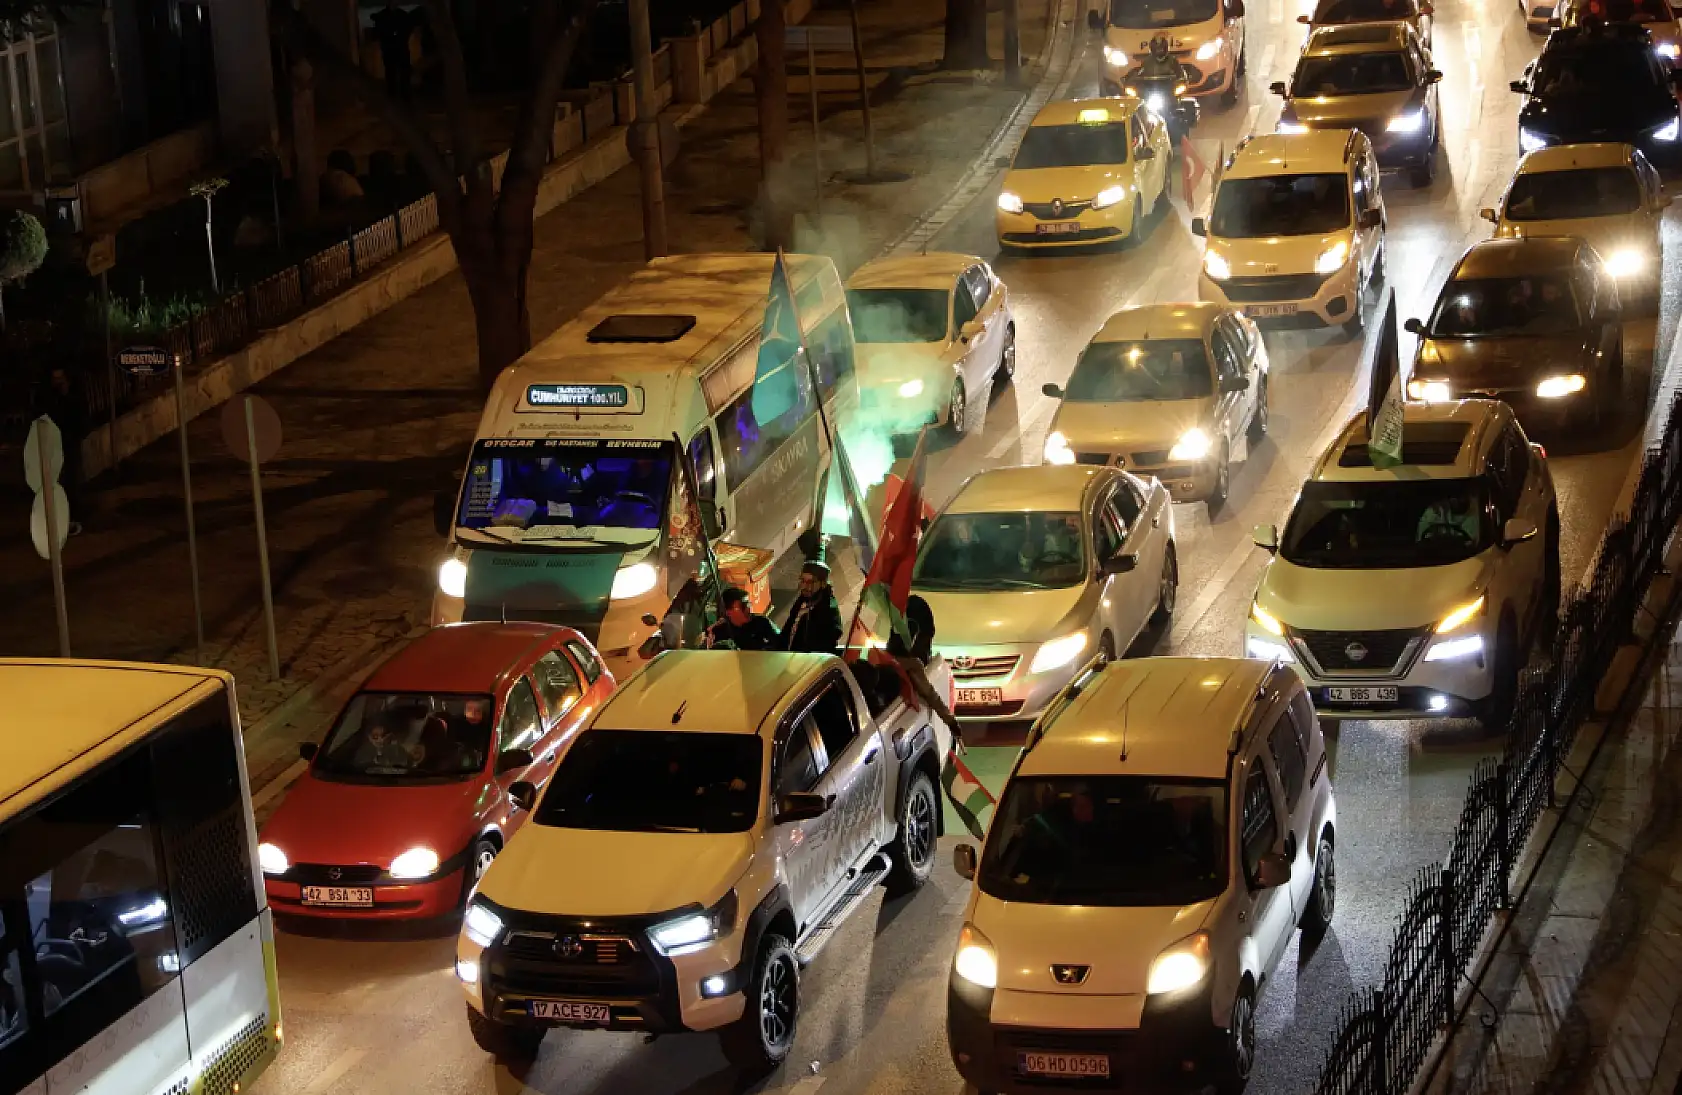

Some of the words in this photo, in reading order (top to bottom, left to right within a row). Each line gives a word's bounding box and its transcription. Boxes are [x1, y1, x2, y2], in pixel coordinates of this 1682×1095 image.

[1330, 688, 1343, 700] 42
[308, 888, 321, 900] 42
[535, 1003, 548, 1016] 17
[552, 1003, 582, 1018] ACE
[583, 1005, 608, 1020] 927
[1027, 1055, 1046, 1070] 06
[1048, 1056, 1067, 1072] HD
